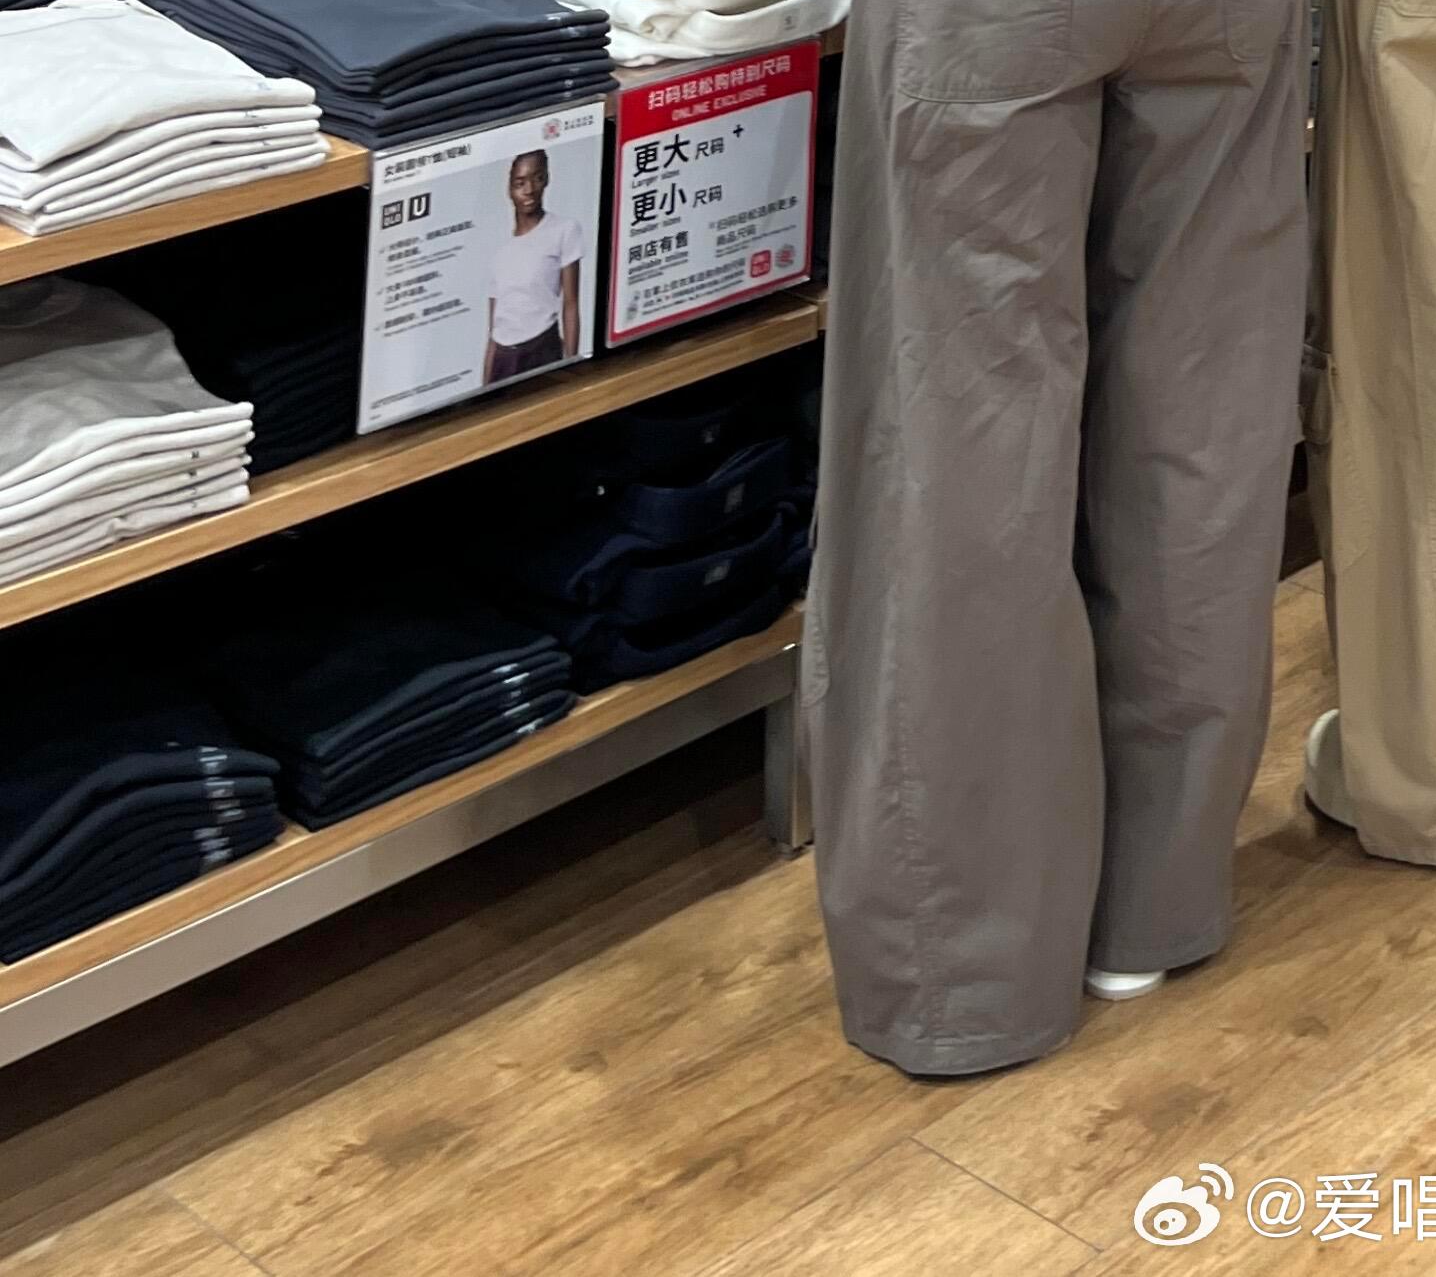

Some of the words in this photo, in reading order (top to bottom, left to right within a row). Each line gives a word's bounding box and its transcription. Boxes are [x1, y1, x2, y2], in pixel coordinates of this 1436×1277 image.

[648, 55, 791, 110] 扫码轻松购特别尺码
[629, 231, 689, 264] 网店有售
